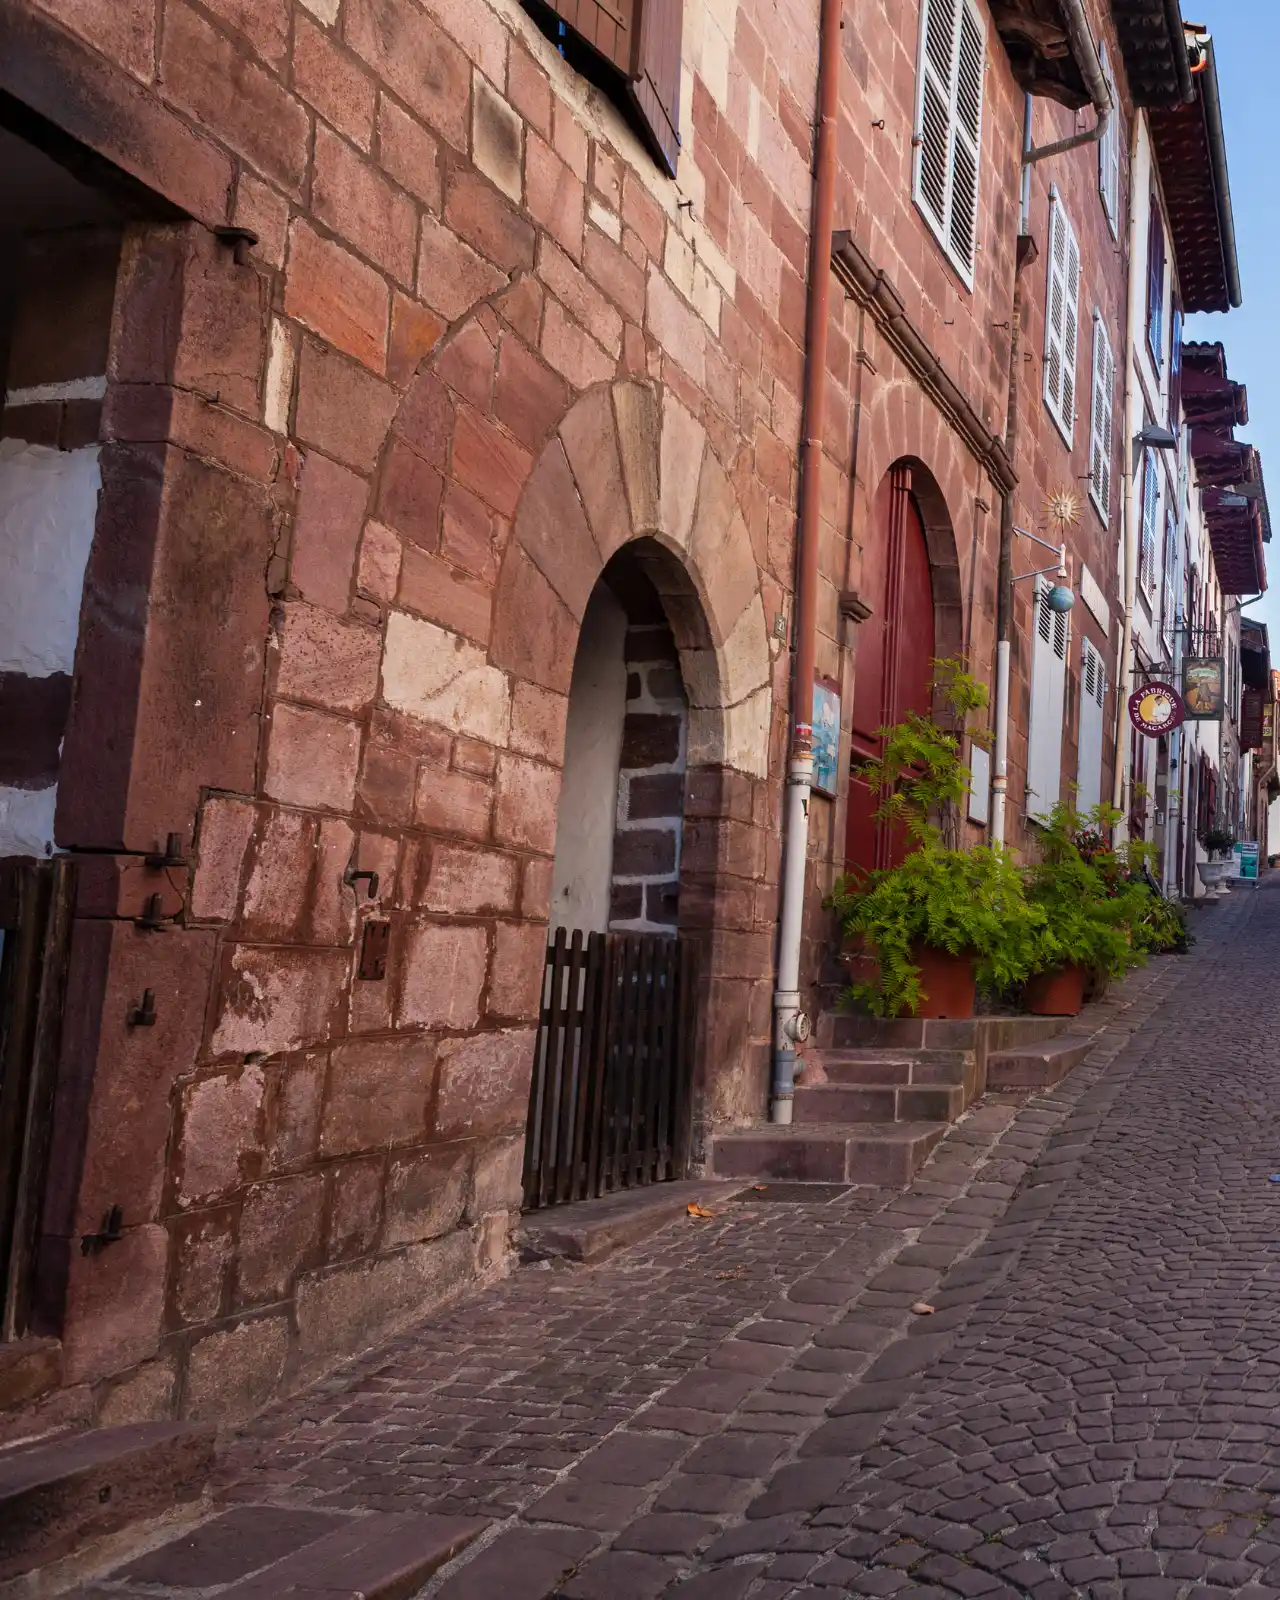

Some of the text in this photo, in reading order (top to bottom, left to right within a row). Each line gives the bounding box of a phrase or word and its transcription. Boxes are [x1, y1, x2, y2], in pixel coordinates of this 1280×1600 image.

[1133, 687, 1177, 711] LA FABRIQUE
[1134, 712, 1141, 722] DE
